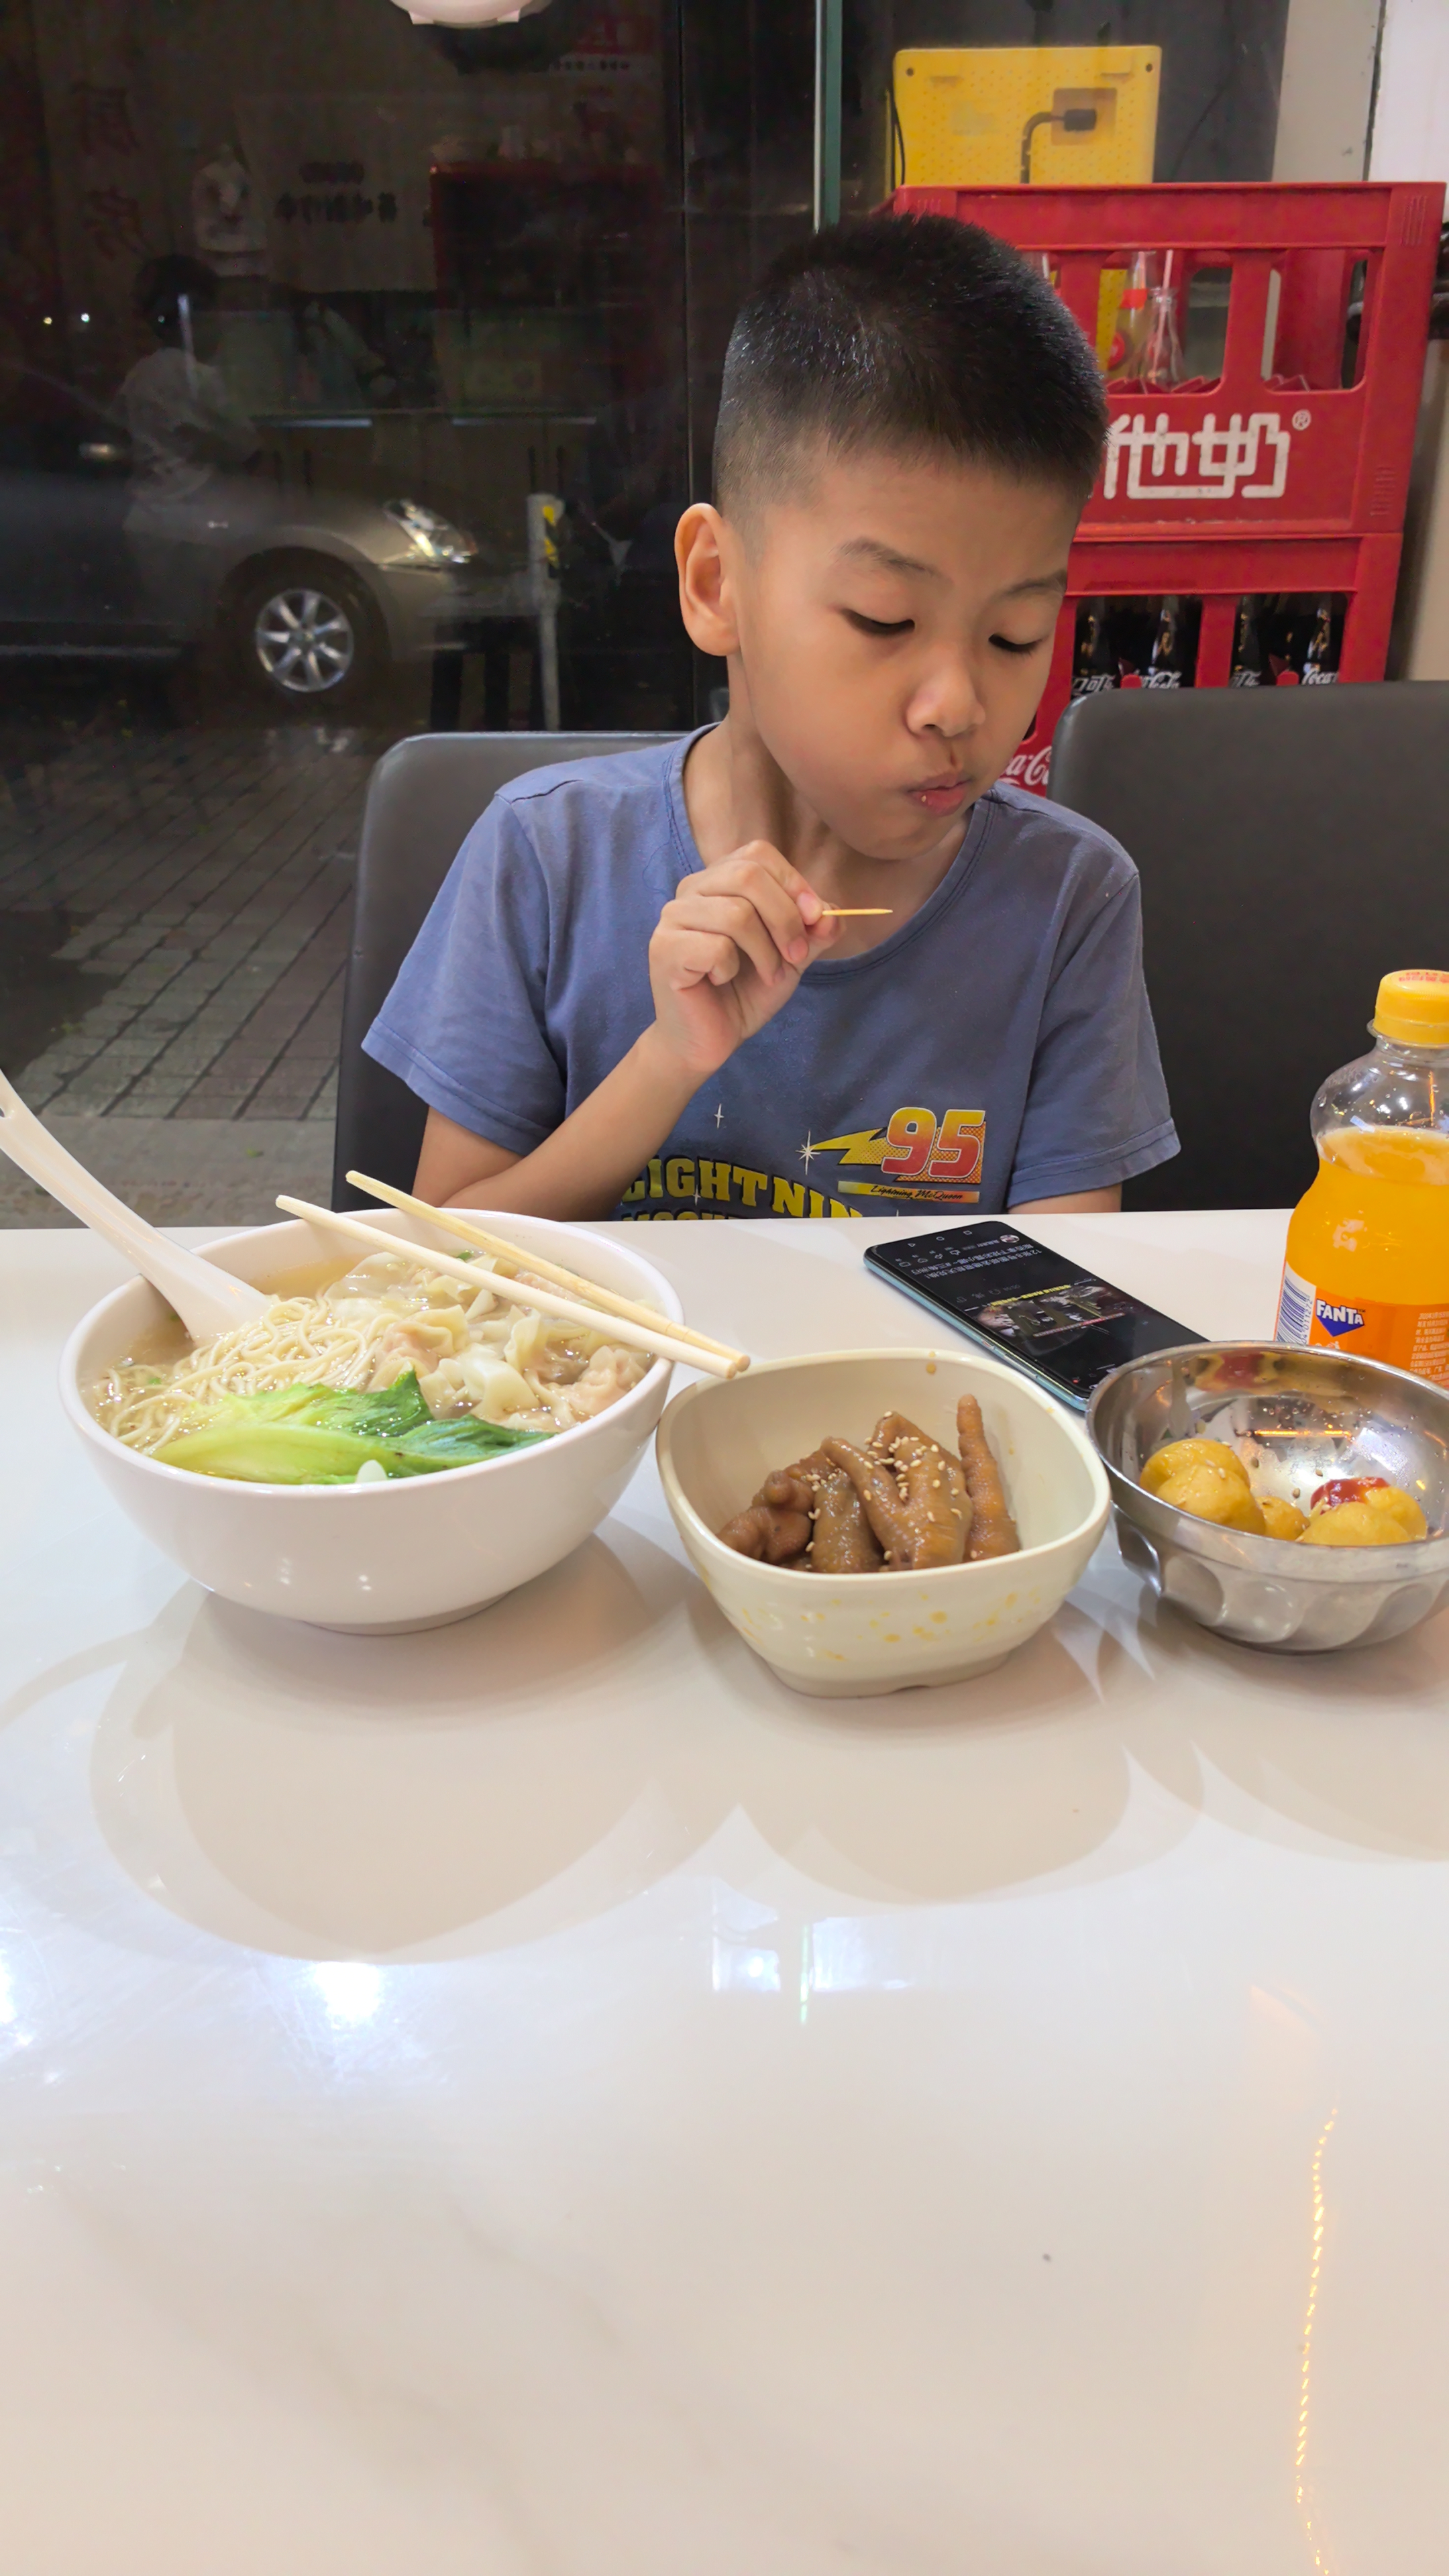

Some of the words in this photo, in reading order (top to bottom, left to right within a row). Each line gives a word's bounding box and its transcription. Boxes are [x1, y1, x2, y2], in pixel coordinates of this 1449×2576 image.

[881, 1106, 986, 1179] 95
[870, 1185, 913, 1199] Lightning
[914, 1188, 963, 1201] McQueen
[1316, 1299, 1364, 1326] FANTA
